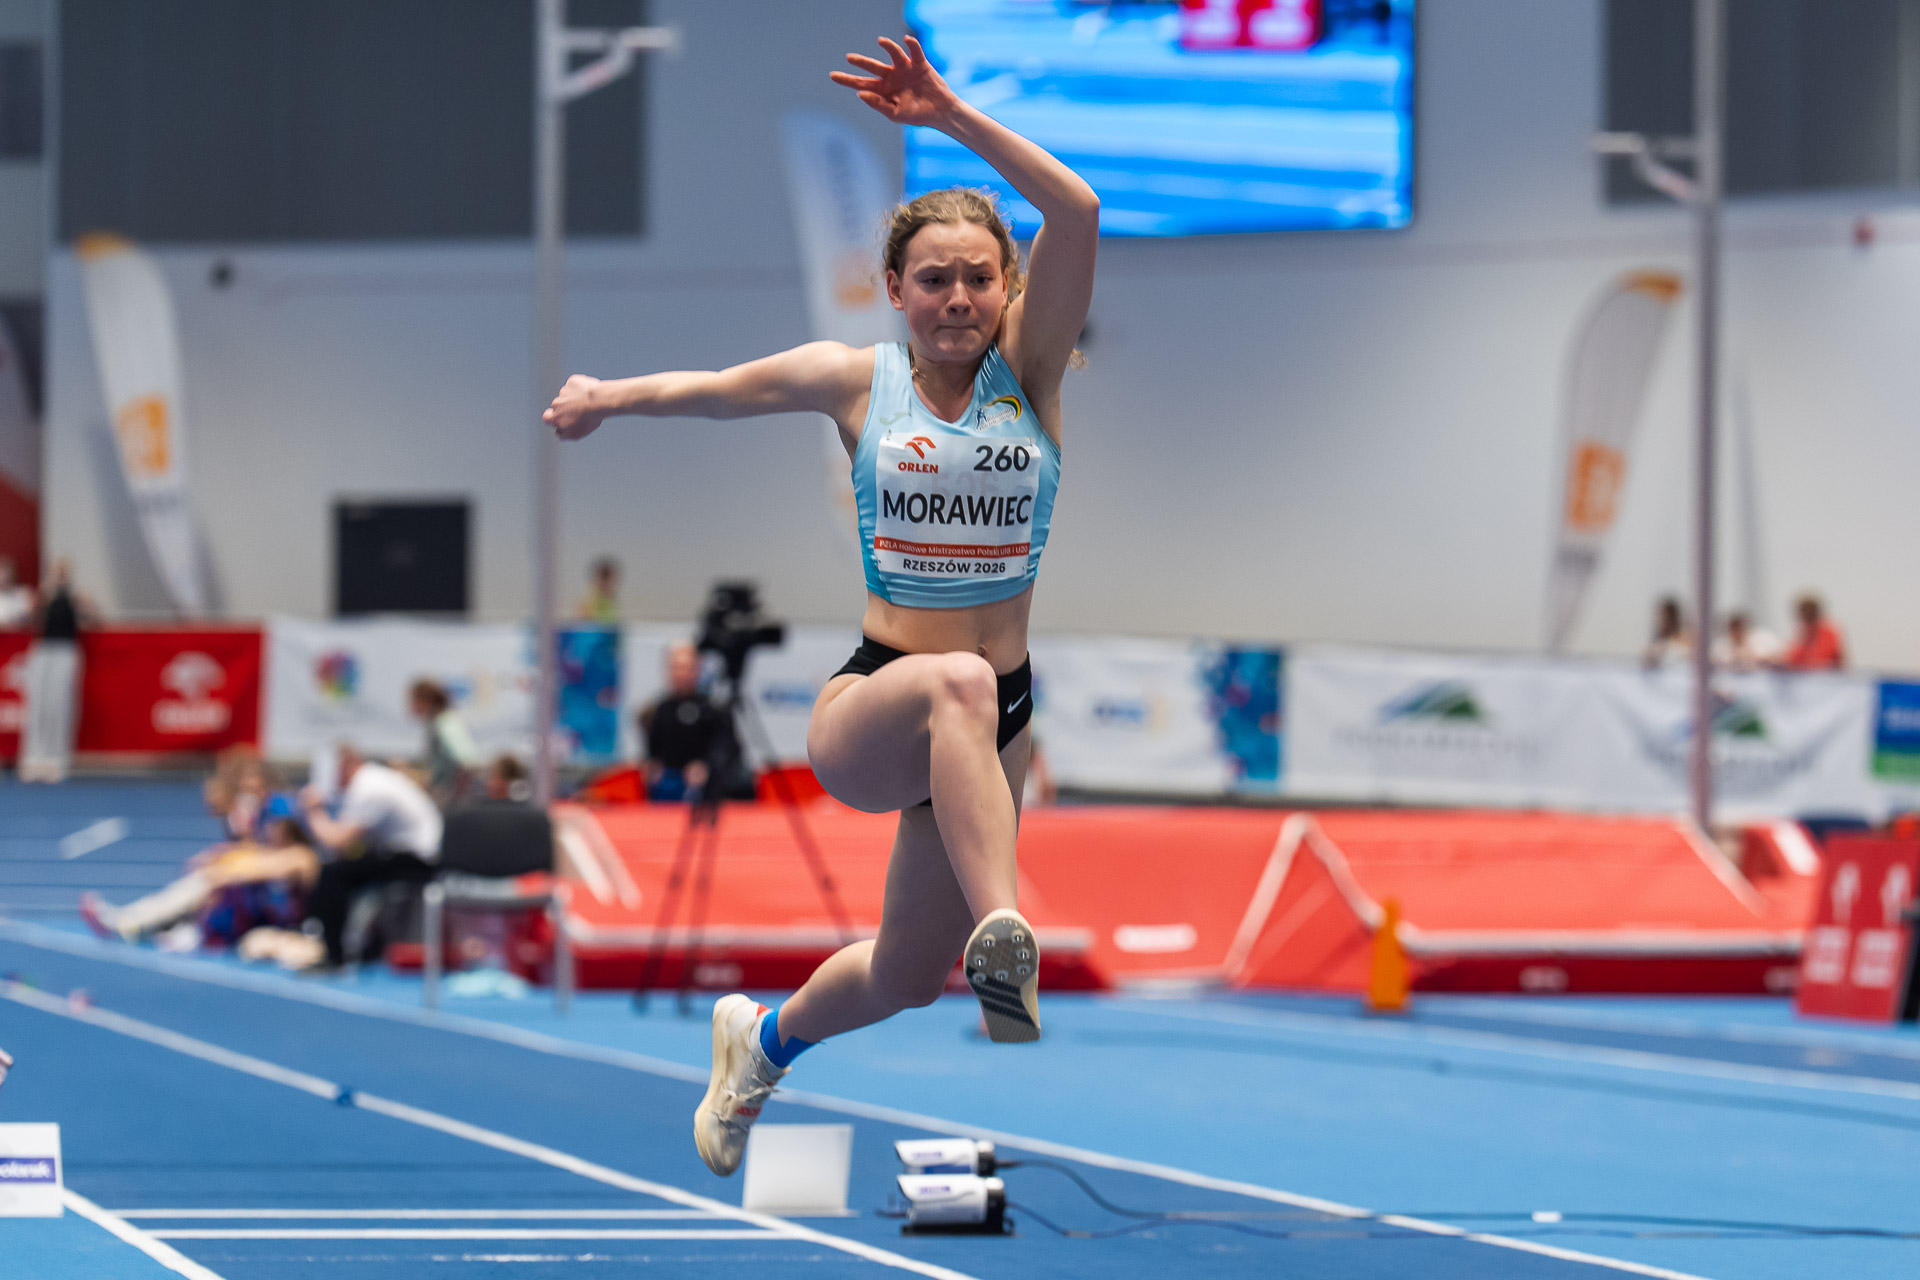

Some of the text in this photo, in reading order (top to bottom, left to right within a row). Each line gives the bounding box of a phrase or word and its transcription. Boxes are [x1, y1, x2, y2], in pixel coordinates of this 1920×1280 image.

[973, 445, 1030, 472] 260
[898, 461, 939, 474] ORLEN
[882, 489, 1032, 527] MORAWIEC
[879, 539, 898, 549] PZLA
[899, 543, 927, 554] Halowe
[928, 546, 976, 556] Mistrzostwa
[903, 558, 1006, 574] RZESZÓW 2026
